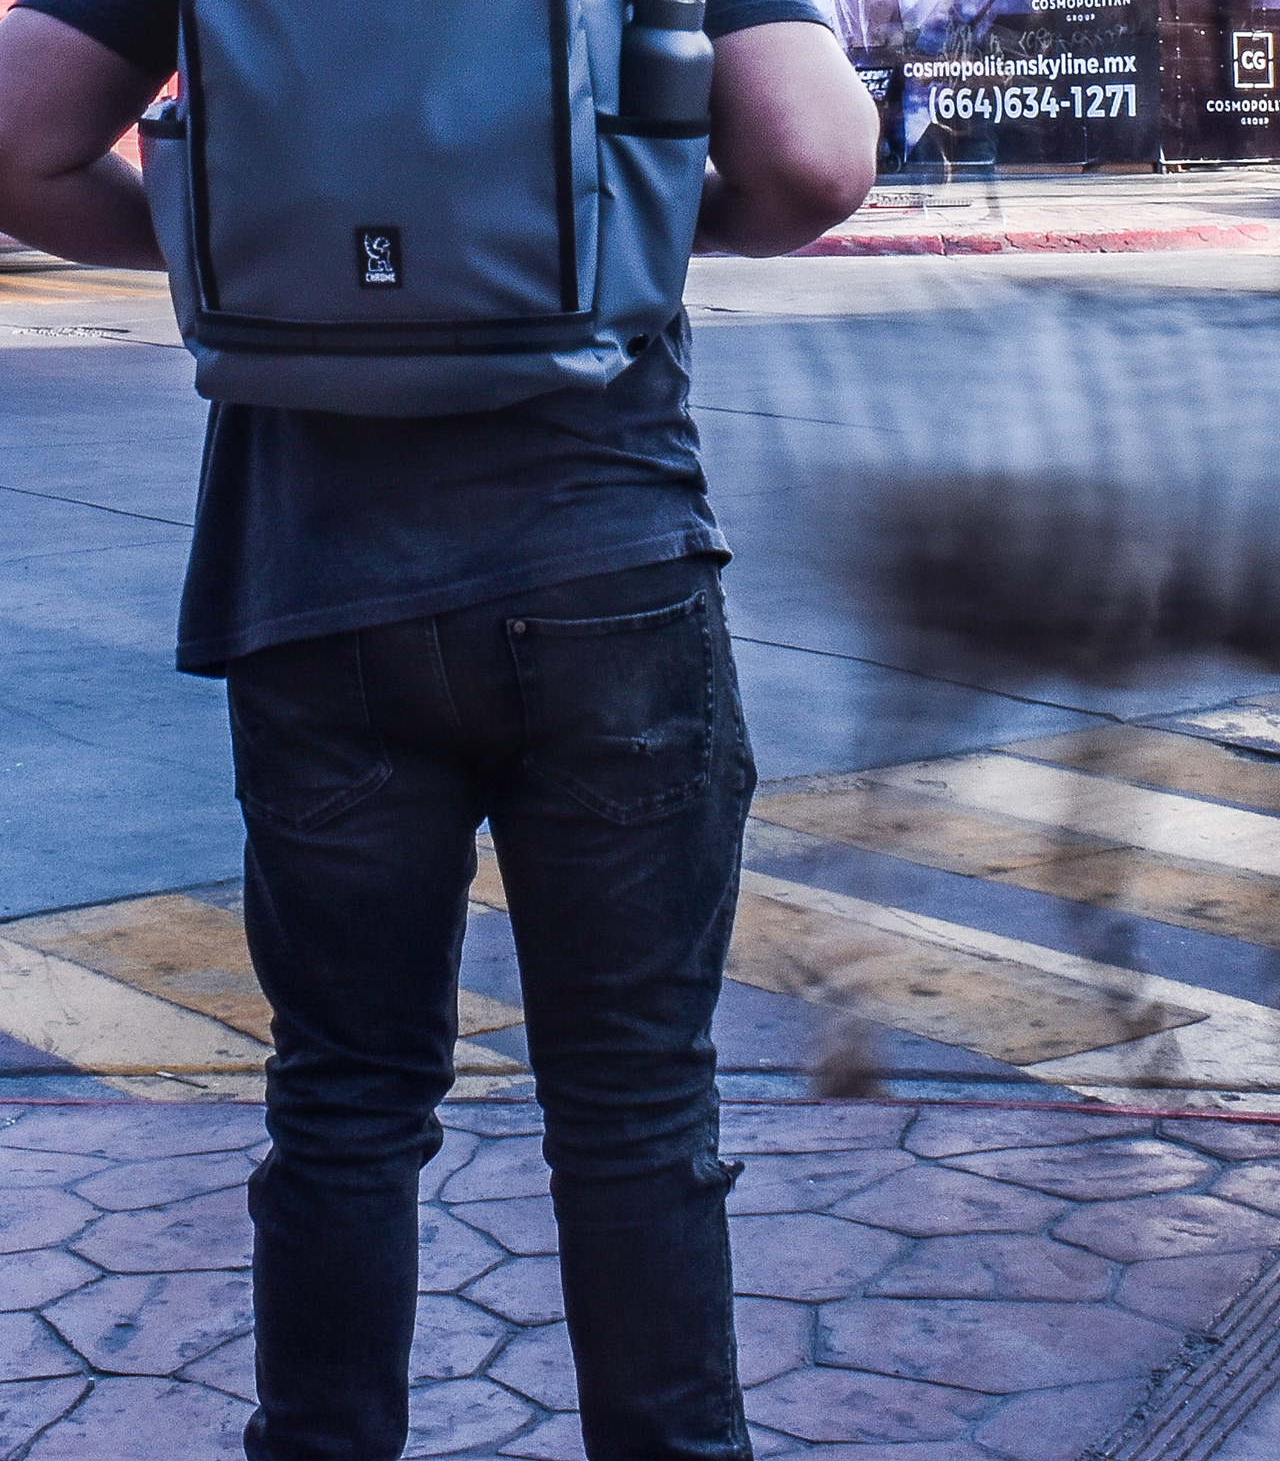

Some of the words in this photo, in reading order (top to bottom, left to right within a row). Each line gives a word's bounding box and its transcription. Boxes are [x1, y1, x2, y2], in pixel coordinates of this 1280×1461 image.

[1066, 13, 1096, 22] GROUP
[903, 53, 1137, 82] cosmopolitanskyline.mx
[1241, 50, 1267, 70] CG
[928, 84, 1137, 124] (664)634-1271
